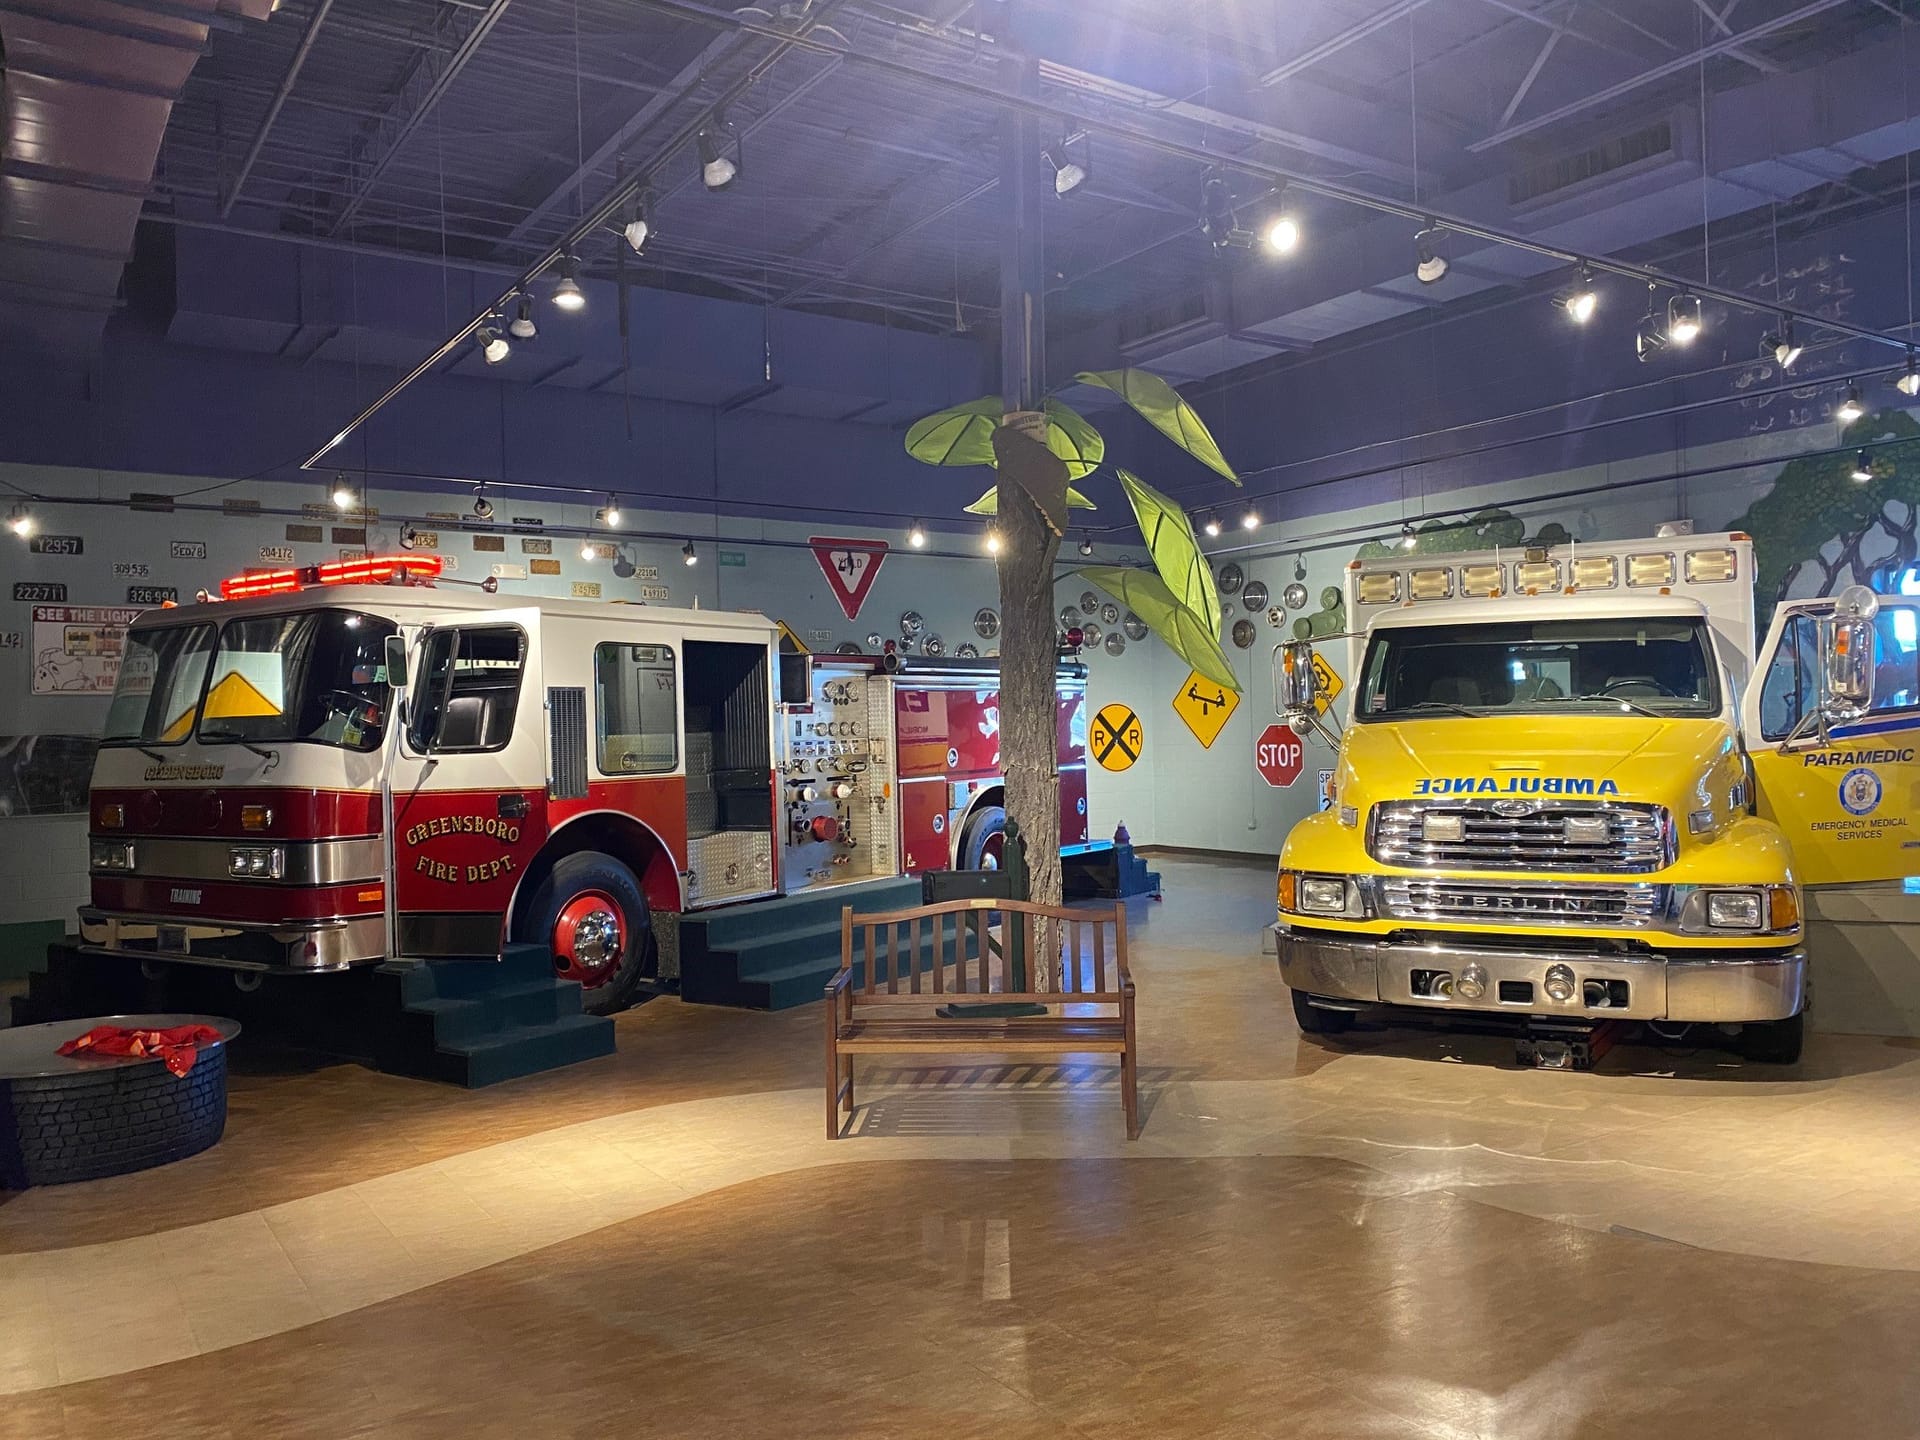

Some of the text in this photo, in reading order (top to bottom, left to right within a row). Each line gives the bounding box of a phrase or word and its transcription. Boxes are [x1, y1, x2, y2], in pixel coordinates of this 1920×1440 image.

[37, 608, 65, 621] SEE
[69, 610, 95, 621] THE
[1094, 729, 1140, 747] R R
[1259, 743, 1300, 767] STOP
[1803, 748, 1915, 767] PARAMEDIC
[406, 815, 520, 845] GREENSBORO
[1810, 818, 1909, 831] EMERGENCY MEDICAL
[1836, 830, 1883, 840] SERVICES
[416, 854, 517, 882] FIRE DEPT.
